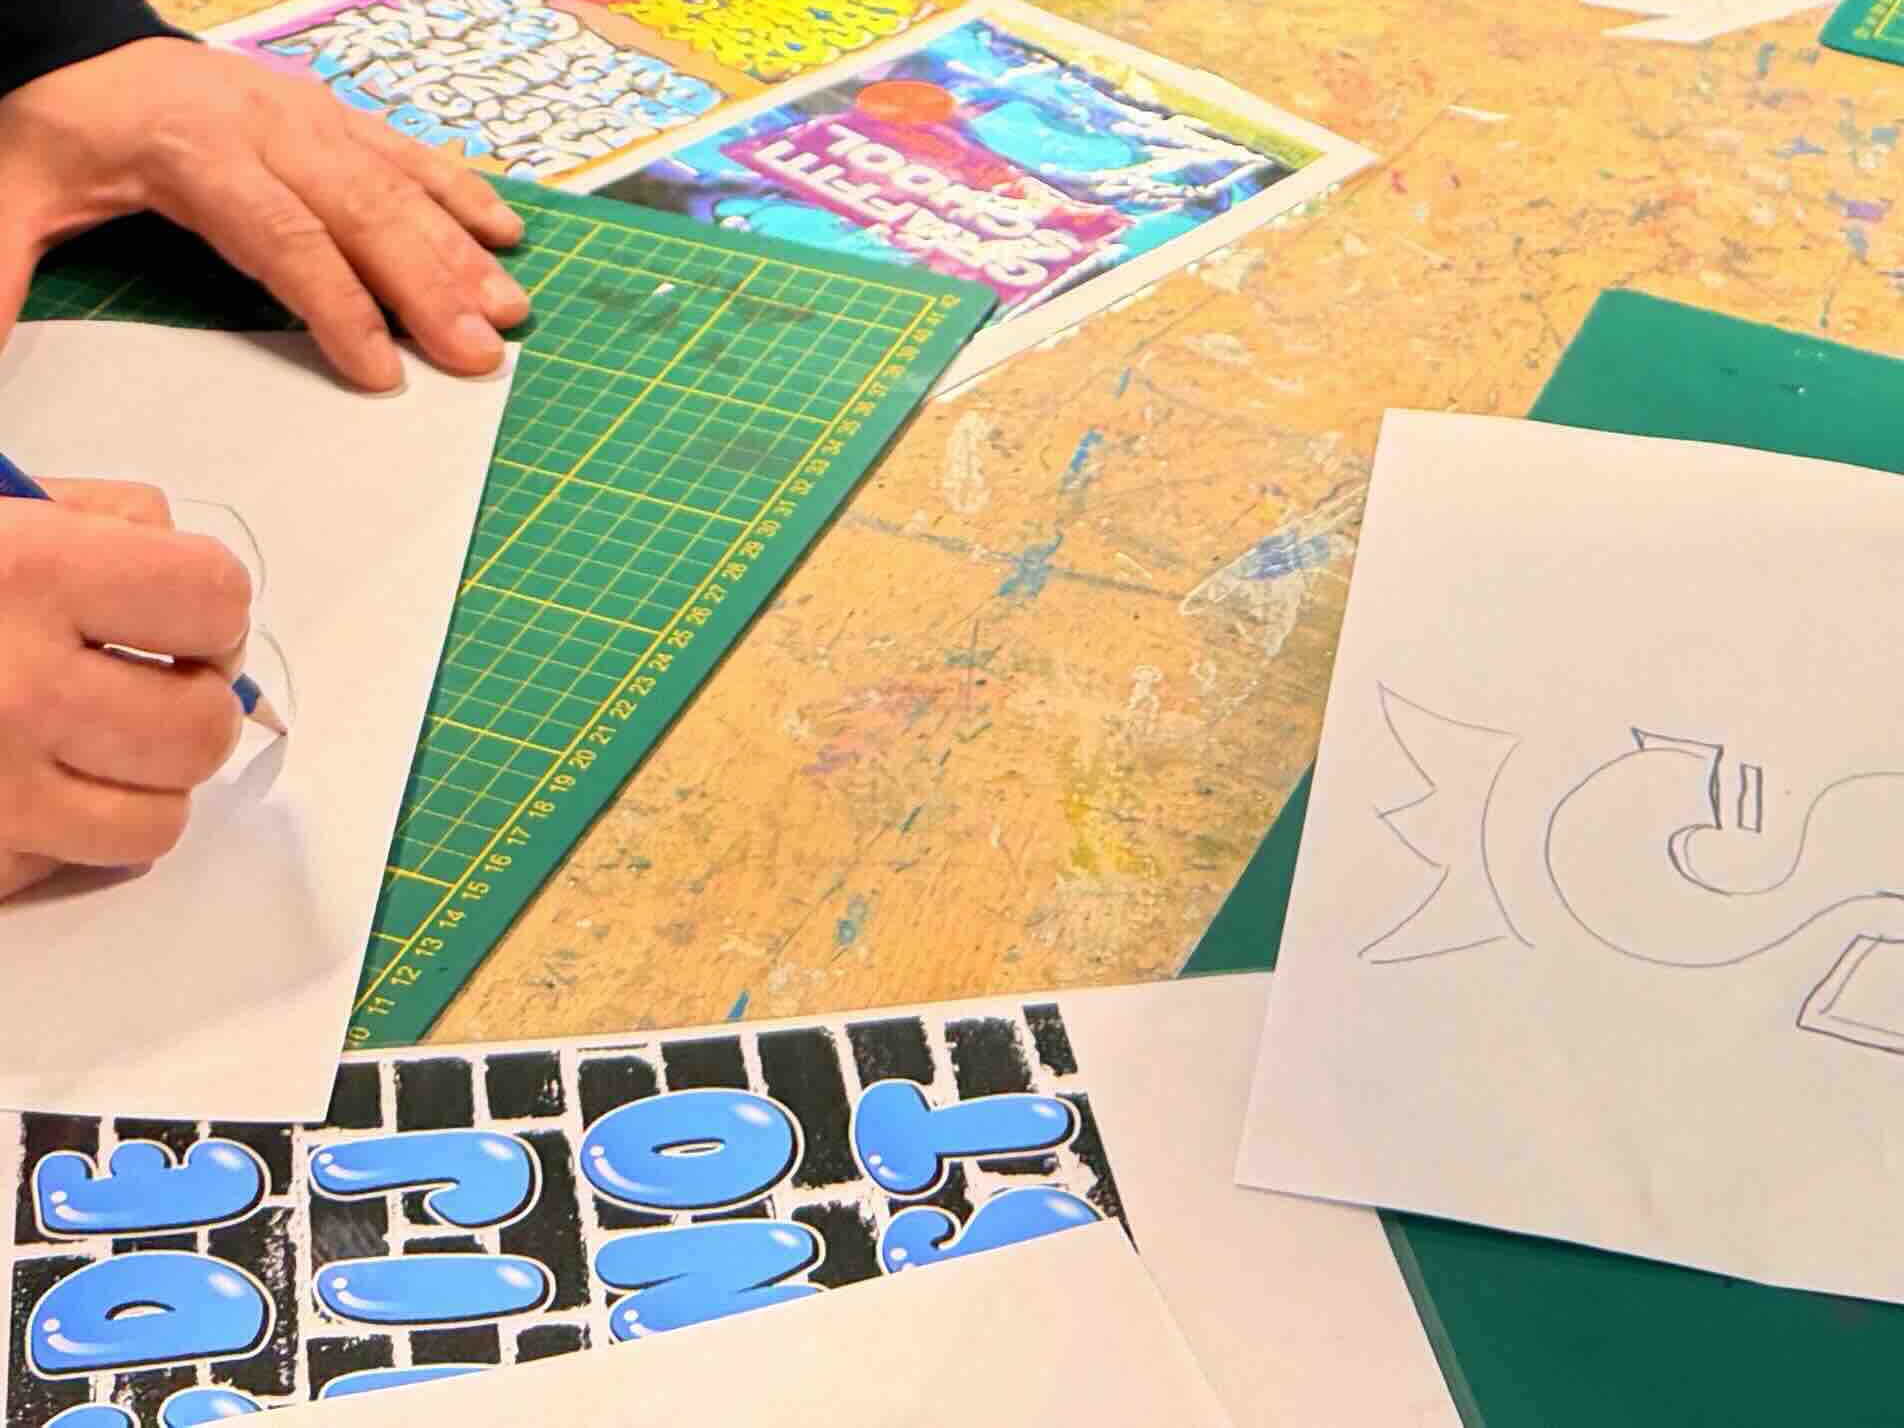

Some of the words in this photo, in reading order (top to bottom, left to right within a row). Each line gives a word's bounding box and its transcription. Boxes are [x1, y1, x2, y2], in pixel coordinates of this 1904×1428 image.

[824, 124, 1081, 265] SCHOOL
[367, 991, 395, 1016] 11
[391, 961, 421, 985] 12
[415, 936, 445, 957] 13
[437, 909, 465, 928] 14
[461, 880, 490, 901] 15
[483, 850, 513, 873] 16
[500, 821, 529, 846] 17
[525, 796, 555, 819] 18
[546, 771, 576, 793] 19
[566, 747, 596, 770] 20
[587, 720, 617, 745] 21
[609, 696, 638, 721] 22
[628, 672, 657, 697] 23
[644, 649, 673, 673] 24
